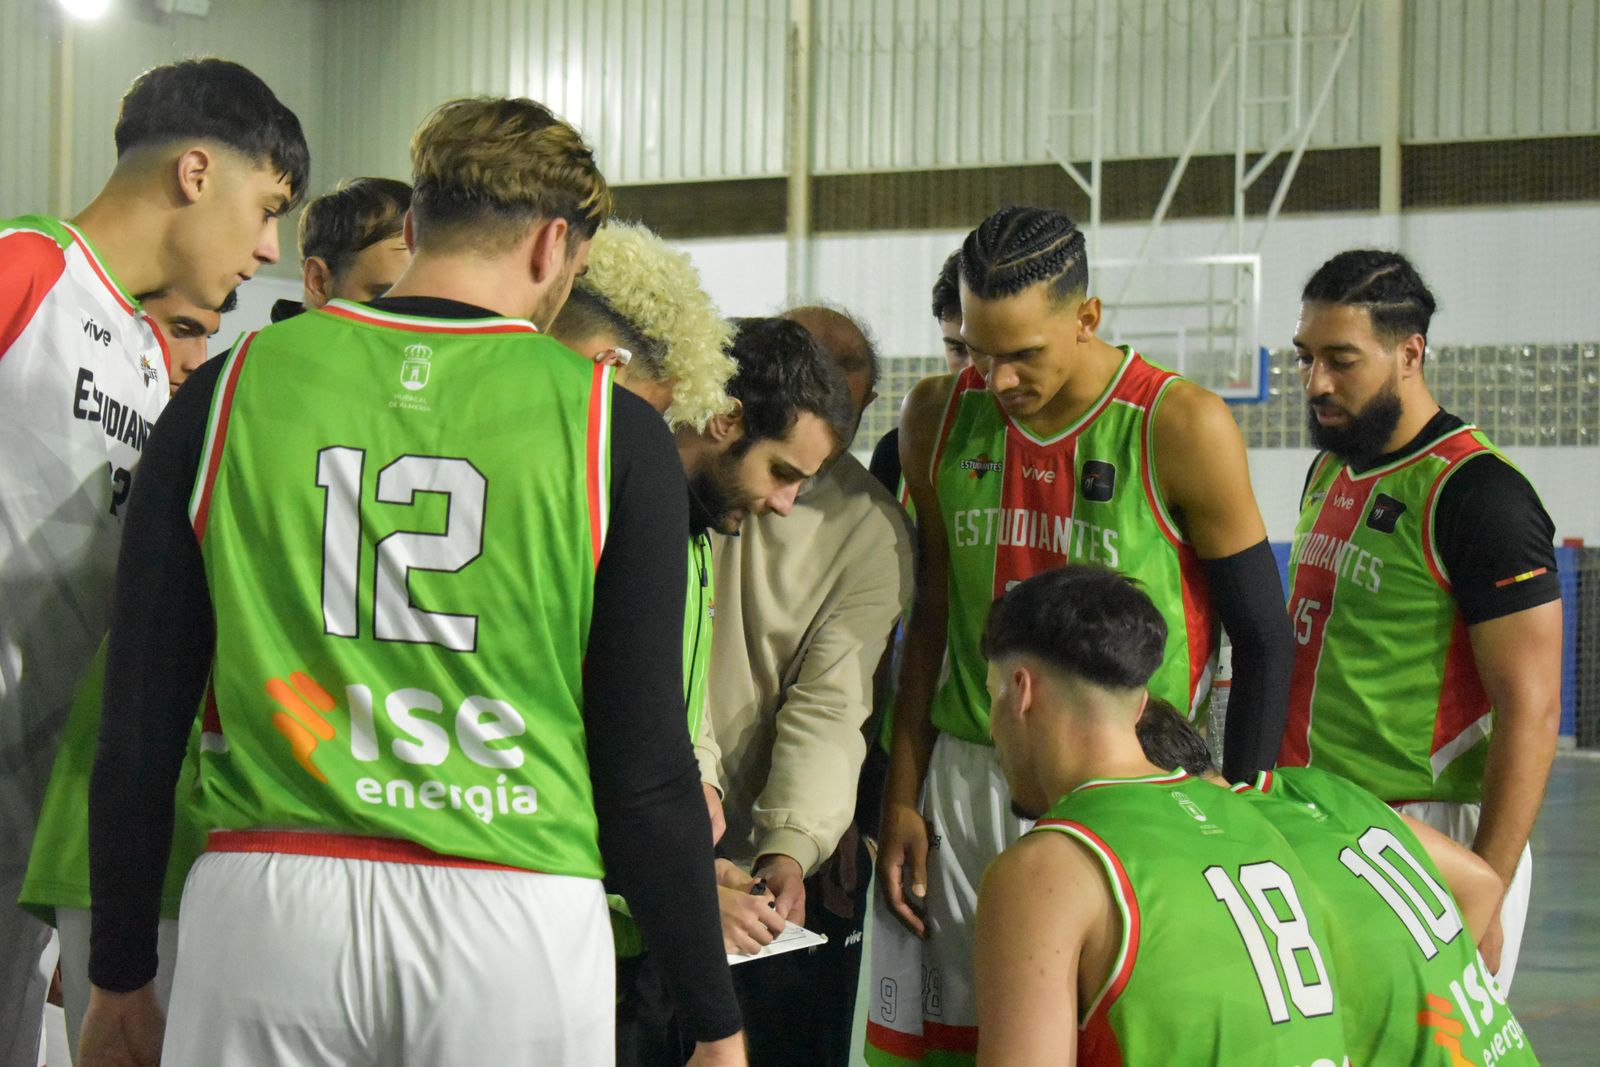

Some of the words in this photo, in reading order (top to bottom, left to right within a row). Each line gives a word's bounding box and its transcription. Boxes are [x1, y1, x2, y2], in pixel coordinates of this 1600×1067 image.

[81, 318, 112, 347] vive
[1022, 464, 1056, 484] vive
[1333, 493, 1355, 510] vive
[315, 445, 488, 653] 12
[954, 508, 1119, 568] ESTUDIANTES
[1289, 532, 1384, 594] TUDIANTES
[1293, 597, 1321, 646] 15
[355, 773, 538, 825] energía
[1338, 826, 1463, 961] 10
[844, 930, 863, 948] vive
[1202, 859, 1334, 1025] 18
[880, 977, 897, 1023] 9
